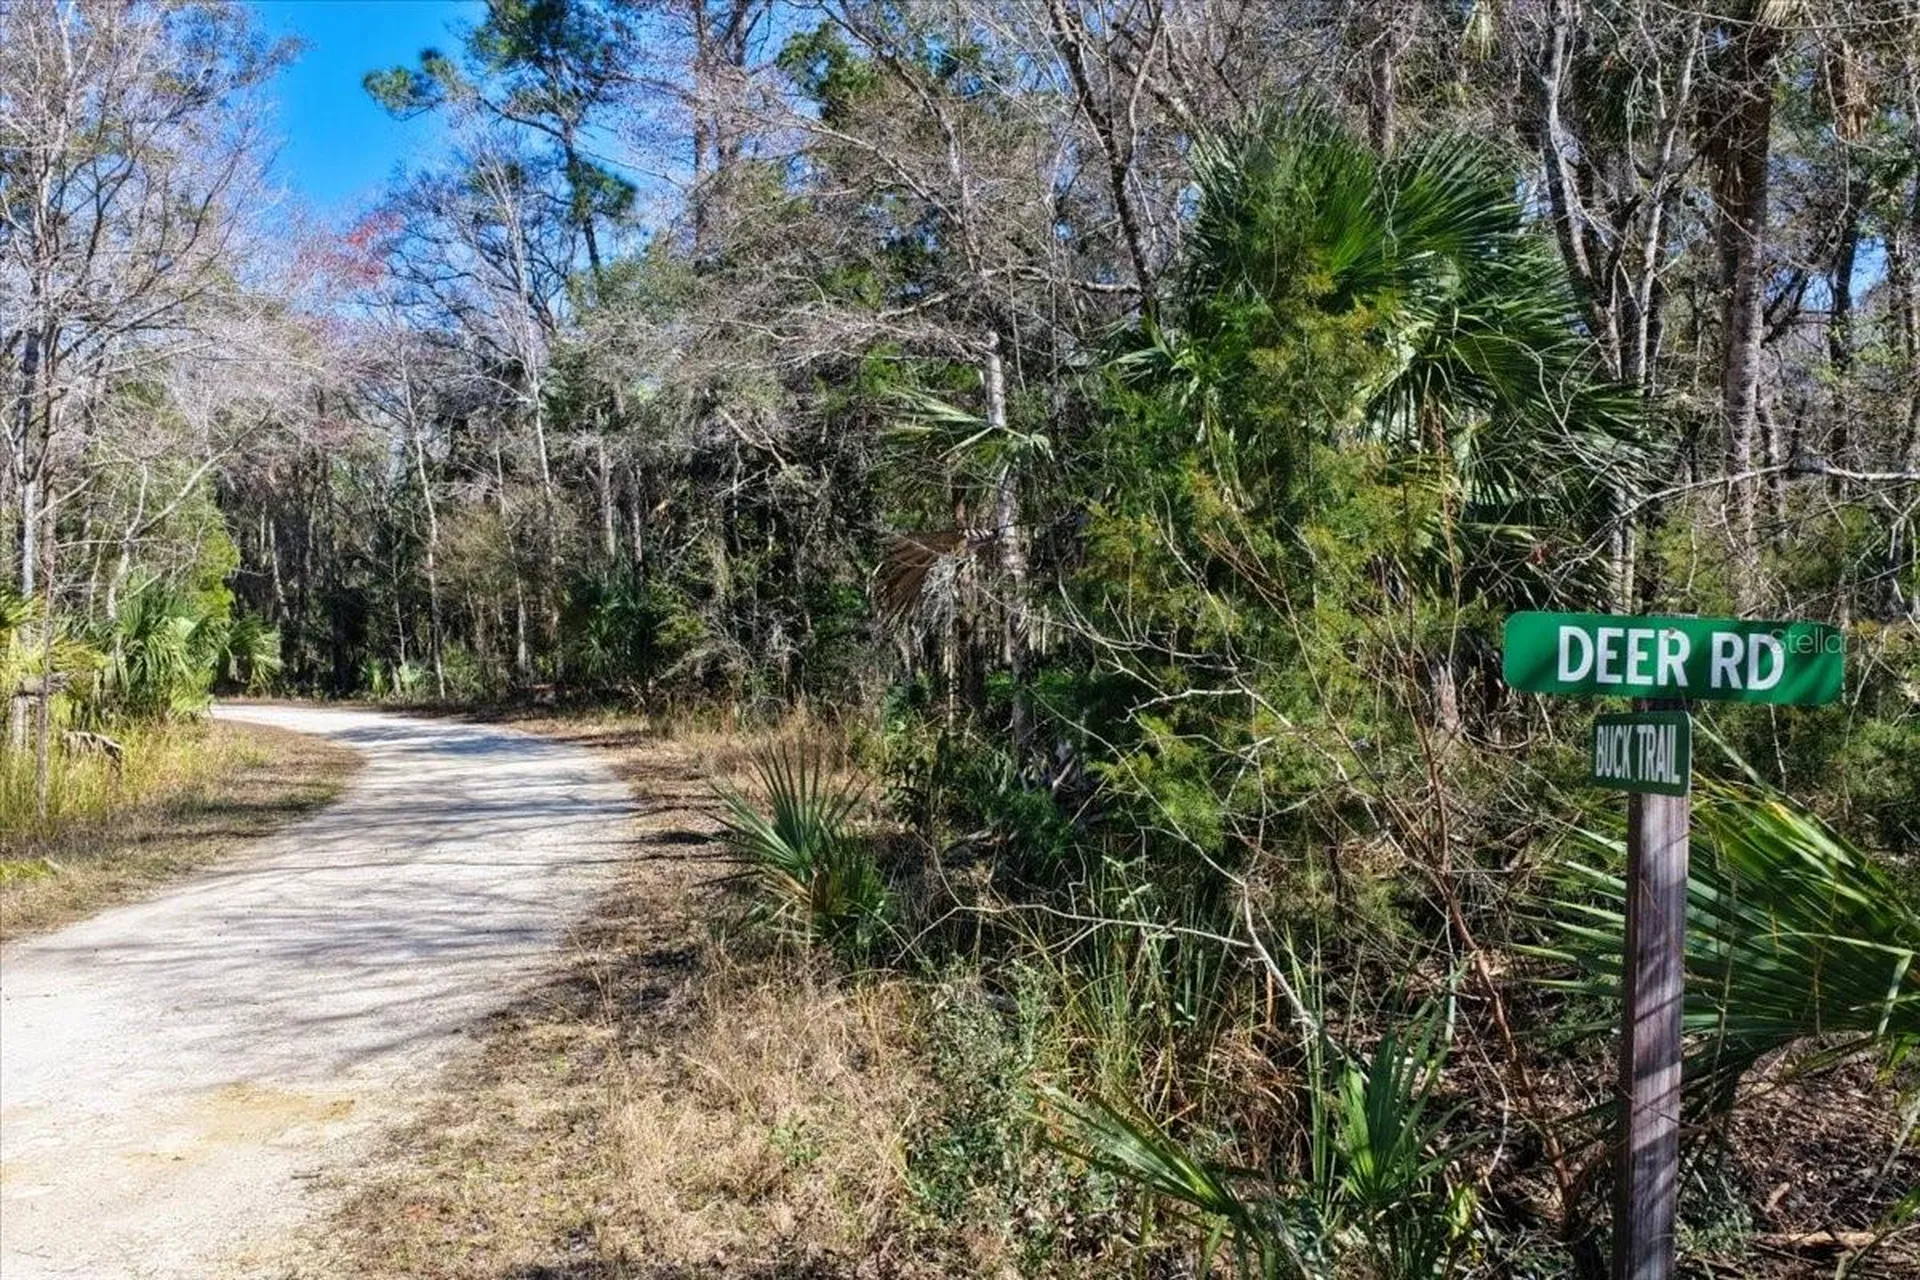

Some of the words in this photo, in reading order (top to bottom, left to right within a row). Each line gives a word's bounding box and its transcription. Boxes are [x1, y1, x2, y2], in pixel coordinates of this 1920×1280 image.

[1558, 625, 1691, 687] DEER
[1710, 631, 1786, 690] RD
[1596, 725, 1632, 780] BUCK
[1636, 724, 1681, 784] TRAIL
